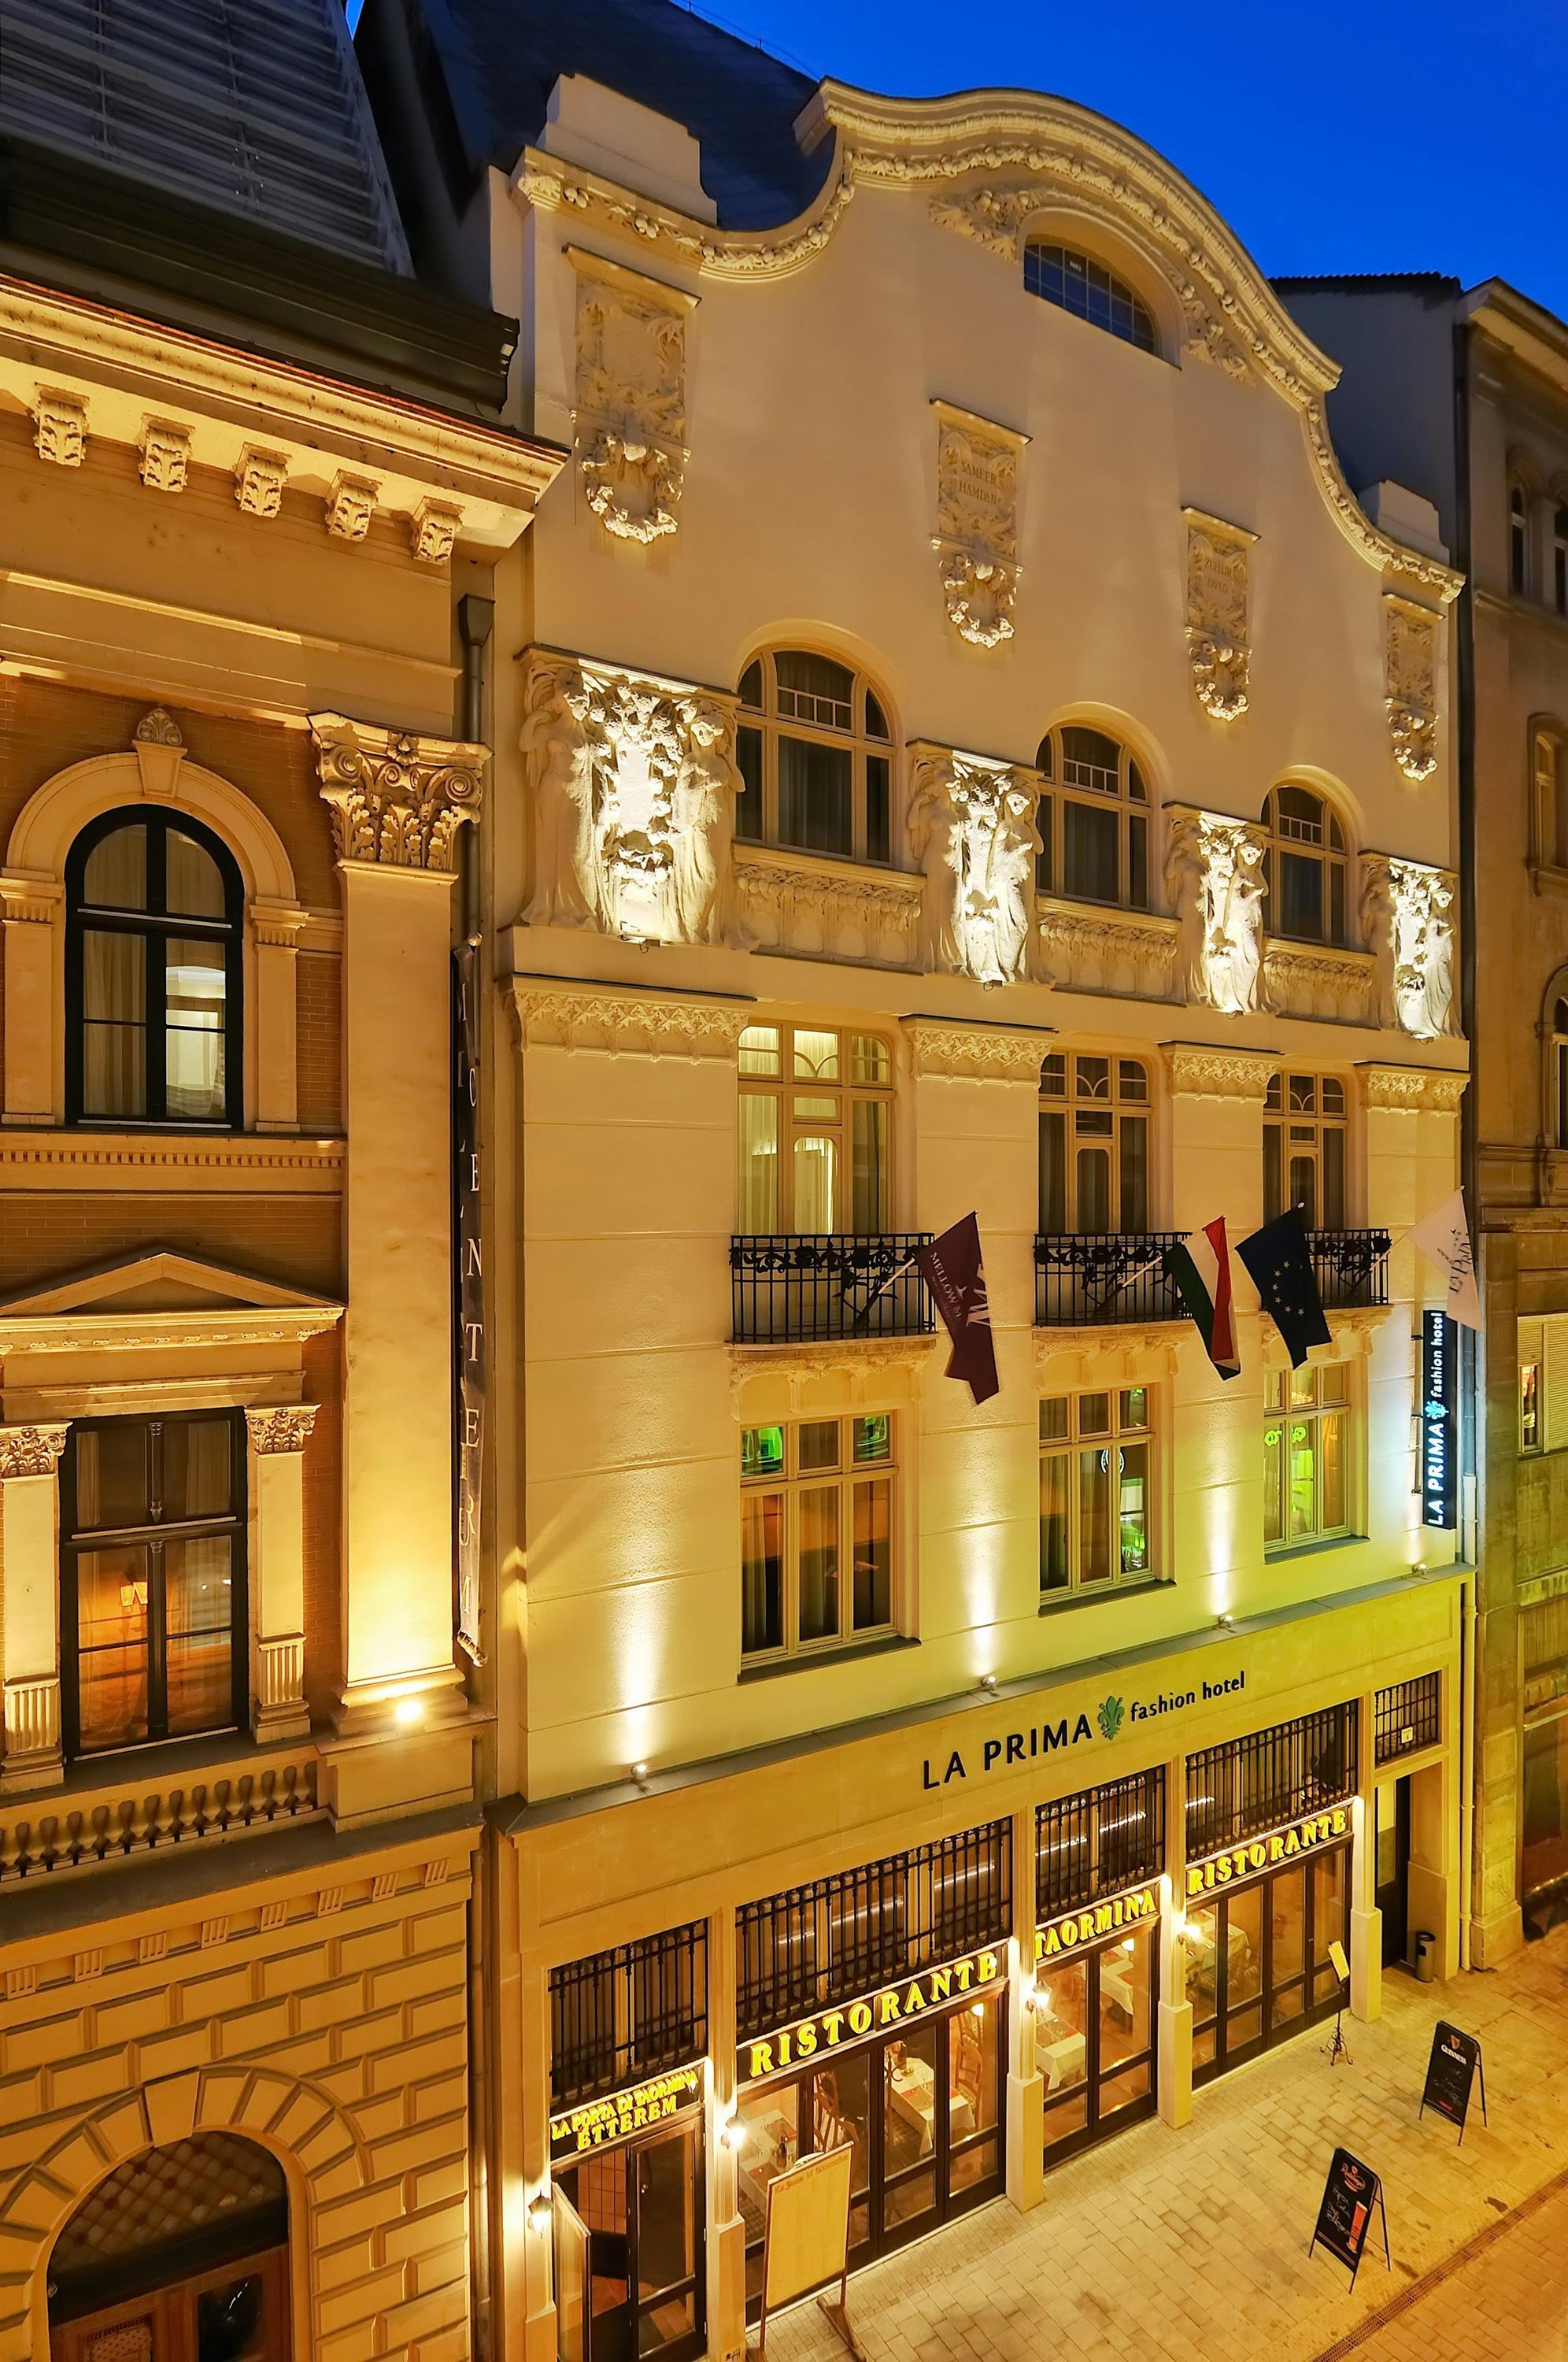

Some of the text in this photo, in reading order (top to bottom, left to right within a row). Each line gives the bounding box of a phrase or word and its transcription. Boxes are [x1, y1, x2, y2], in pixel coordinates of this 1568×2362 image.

[958, 481, 999, 506] HAMDAN
[960, 460, 997, 486] SAMEER
[930, 1252, 957, 1305] MELLOW
[1427, 1312, 1444, 1525] LA PRIMA fashion hotel
[923, 1670, 1245, 1790] LA PRIMA fashion hotel
[1186, 1809, 1347, 1896] RISTORANTE
[1035, 1888, 1157, 1960] TAORMINA
[749, 1951, 998, 2079] RISTORANTE
[550, 2119, 572, 2141] LA
[571, 2101, 617, 2133] PORTA
[616, 2093, 634, 2115] DI
